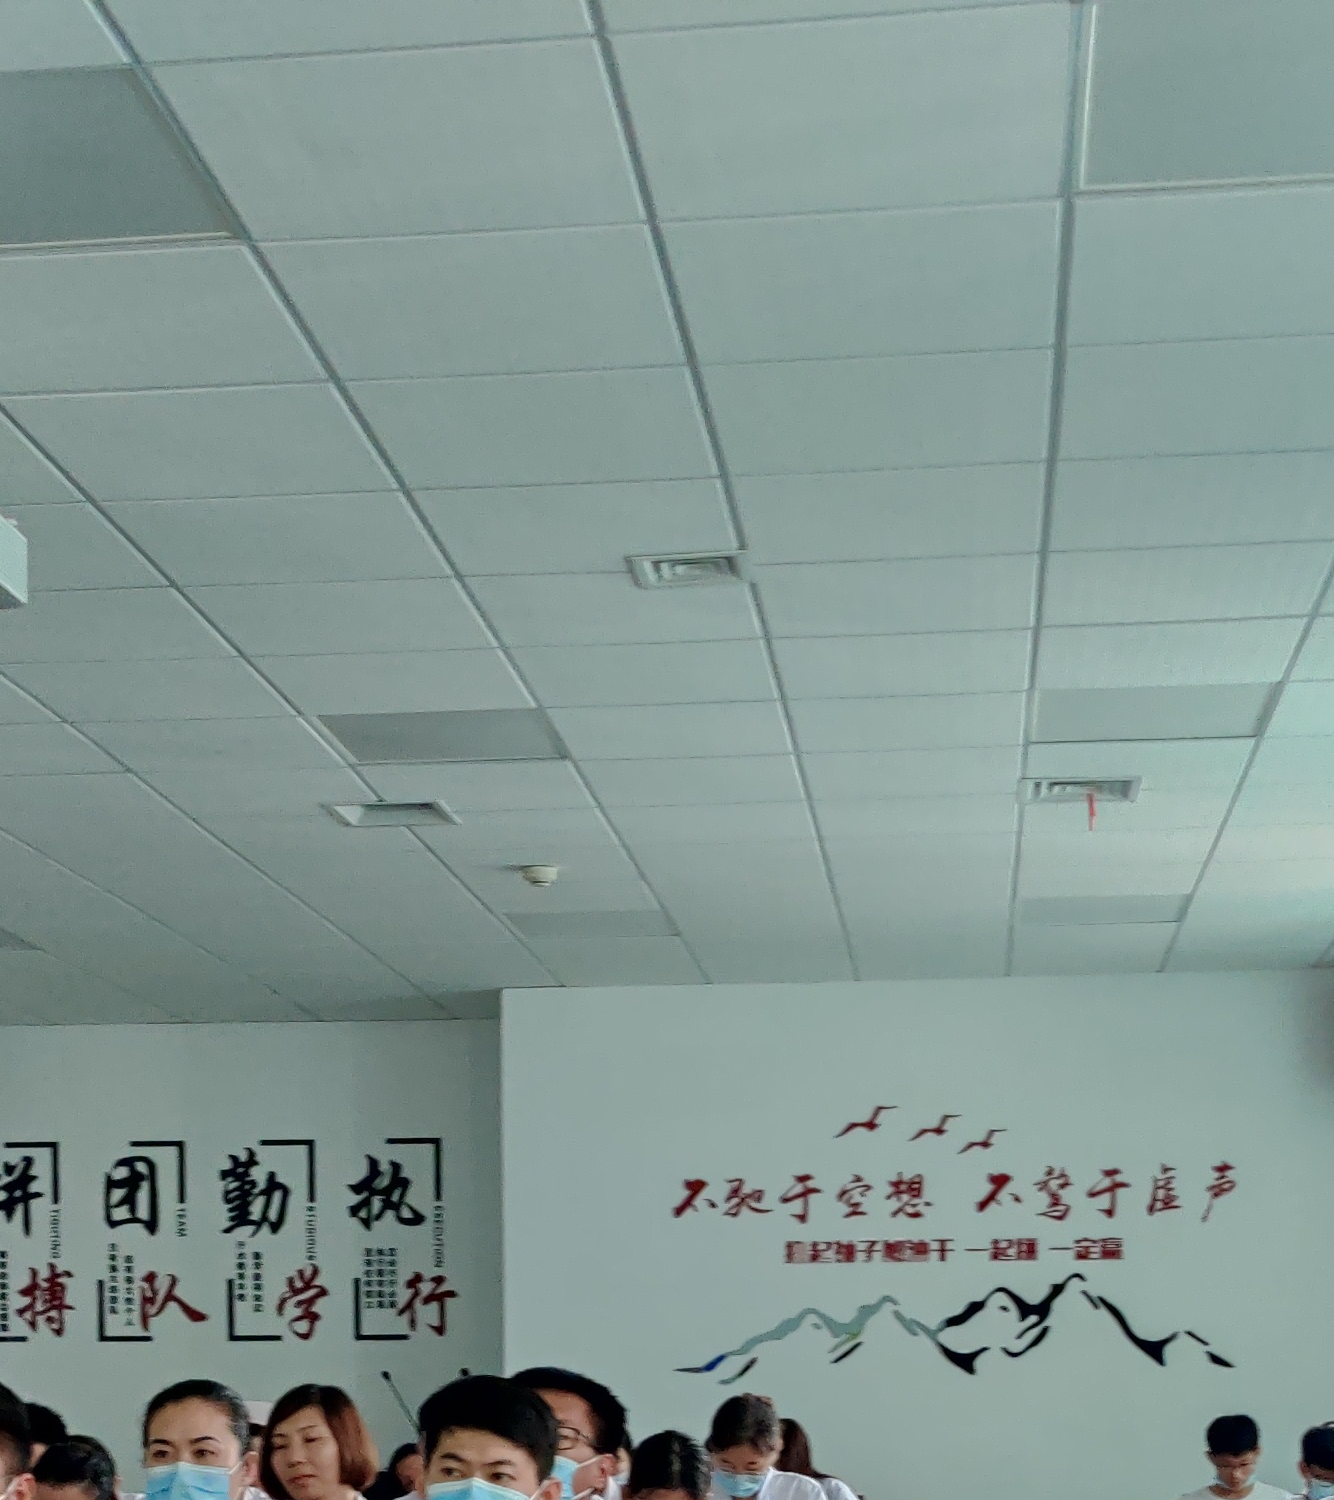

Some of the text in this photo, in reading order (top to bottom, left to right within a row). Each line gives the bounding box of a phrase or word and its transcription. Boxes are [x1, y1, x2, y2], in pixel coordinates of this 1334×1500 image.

[672, 1172, 934, 1223] 不驰于空想
